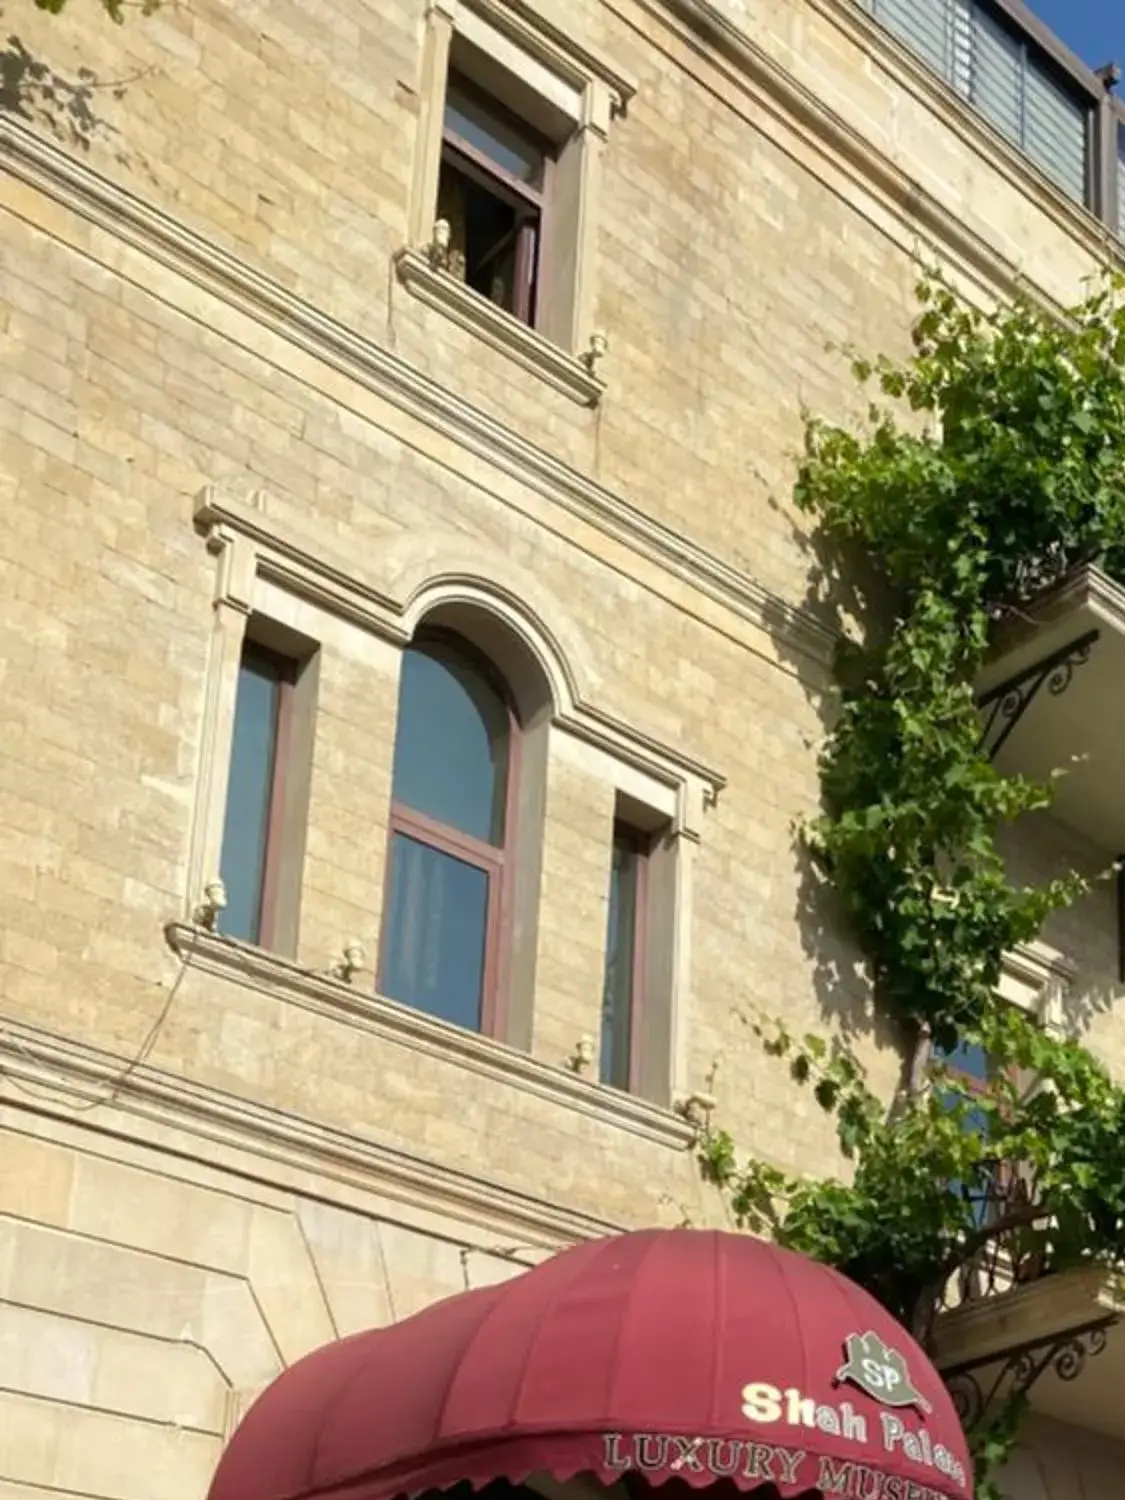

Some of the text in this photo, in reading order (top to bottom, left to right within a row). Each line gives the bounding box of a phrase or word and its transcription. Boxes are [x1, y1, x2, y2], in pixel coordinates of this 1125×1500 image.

[861, 1358, 900, 1392] SP
[741, 1382, 868, 1443] Shah
[604, 1434, 805, 1485] LUXURY
